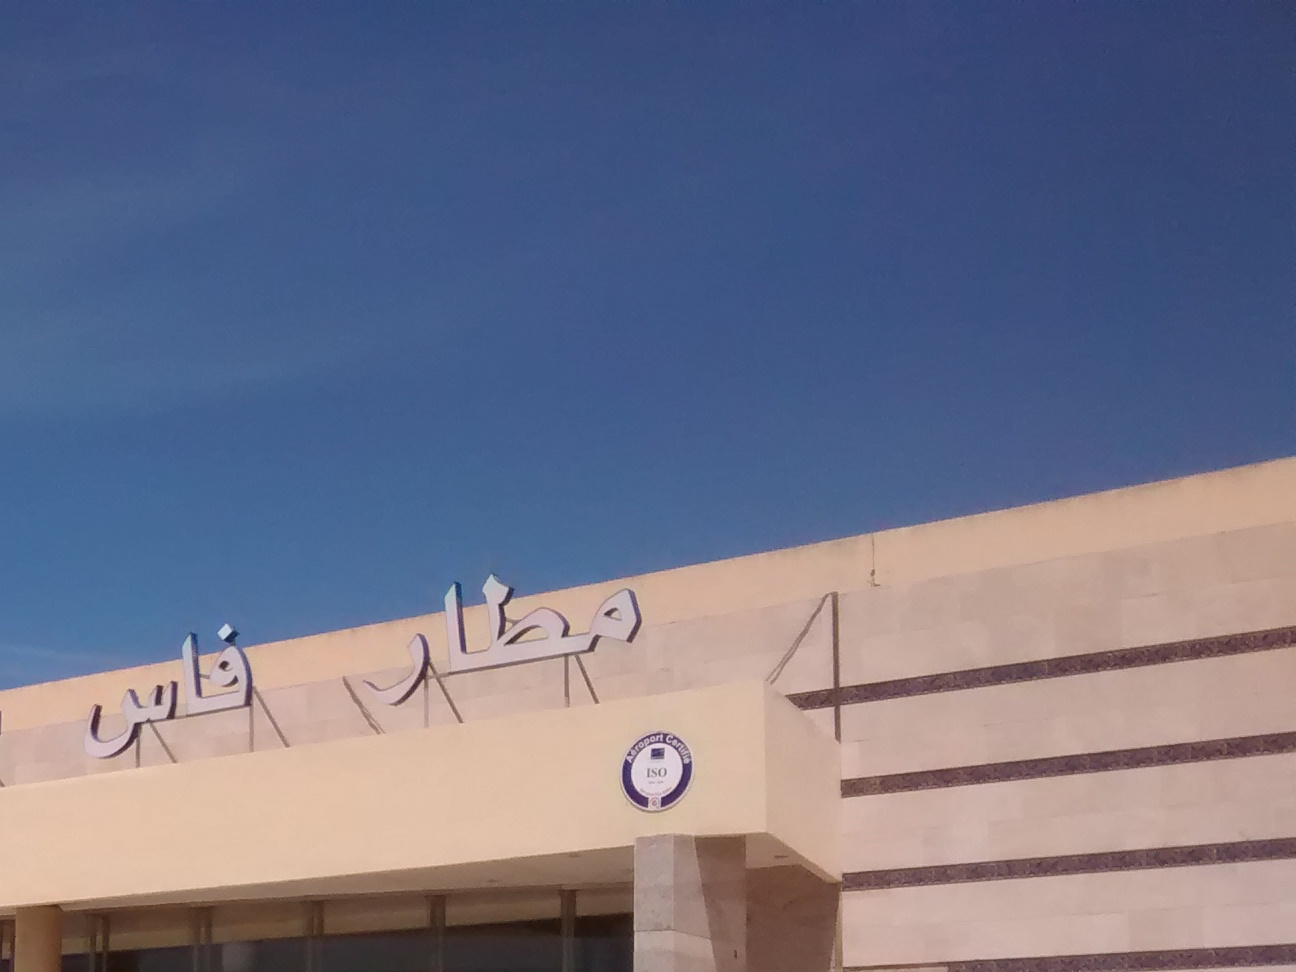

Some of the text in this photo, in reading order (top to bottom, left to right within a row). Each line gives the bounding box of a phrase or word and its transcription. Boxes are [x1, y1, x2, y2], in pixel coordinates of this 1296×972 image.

[84, 623, 253, 759] فاس
[362, 573, 642, 706] مطار
[646, 767, 667, 778] ISO
